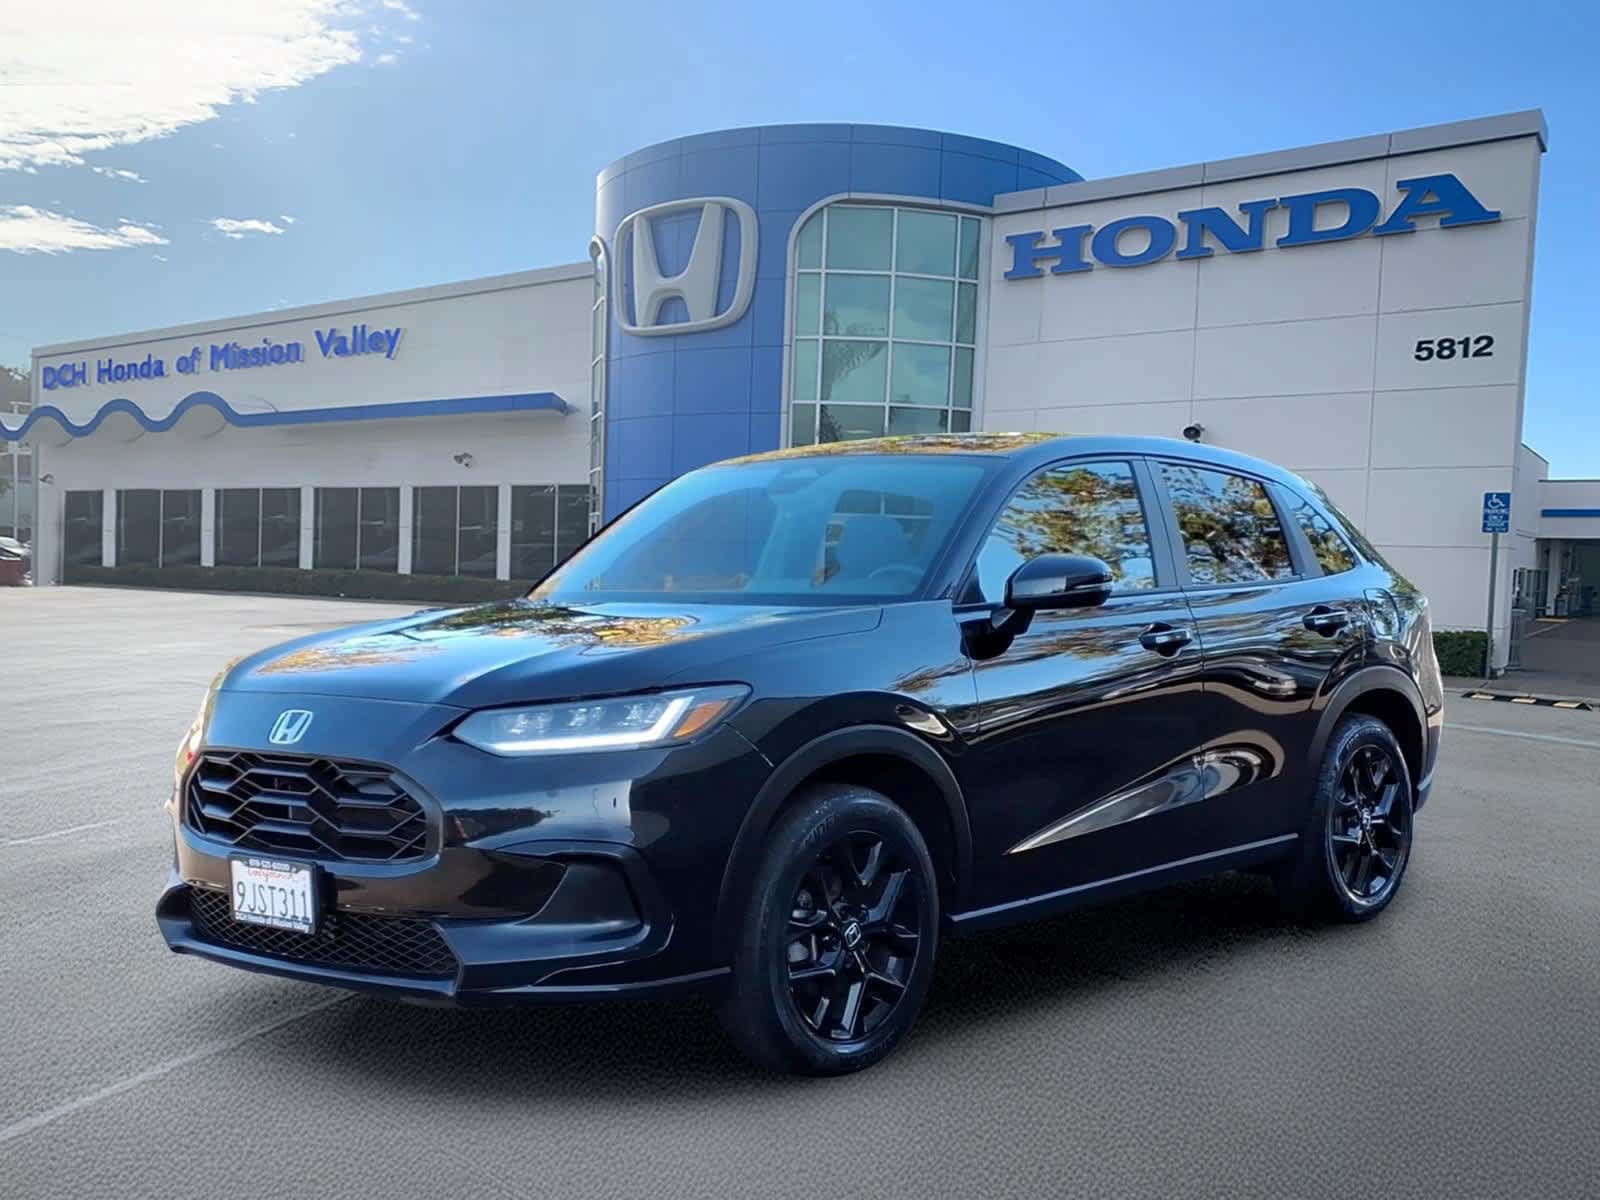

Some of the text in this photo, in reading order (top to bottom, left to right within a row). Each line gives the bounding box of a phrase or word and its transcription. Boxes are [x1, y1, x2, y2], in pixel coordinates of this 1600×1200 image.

[1004, 173, 1501, 280] HONDA
[42, 325, 402, 390] DCH Honda of Mission Valley
[1414, 335, 1494, 361] 5812
[237, 880, 310, 921] 9JST311
